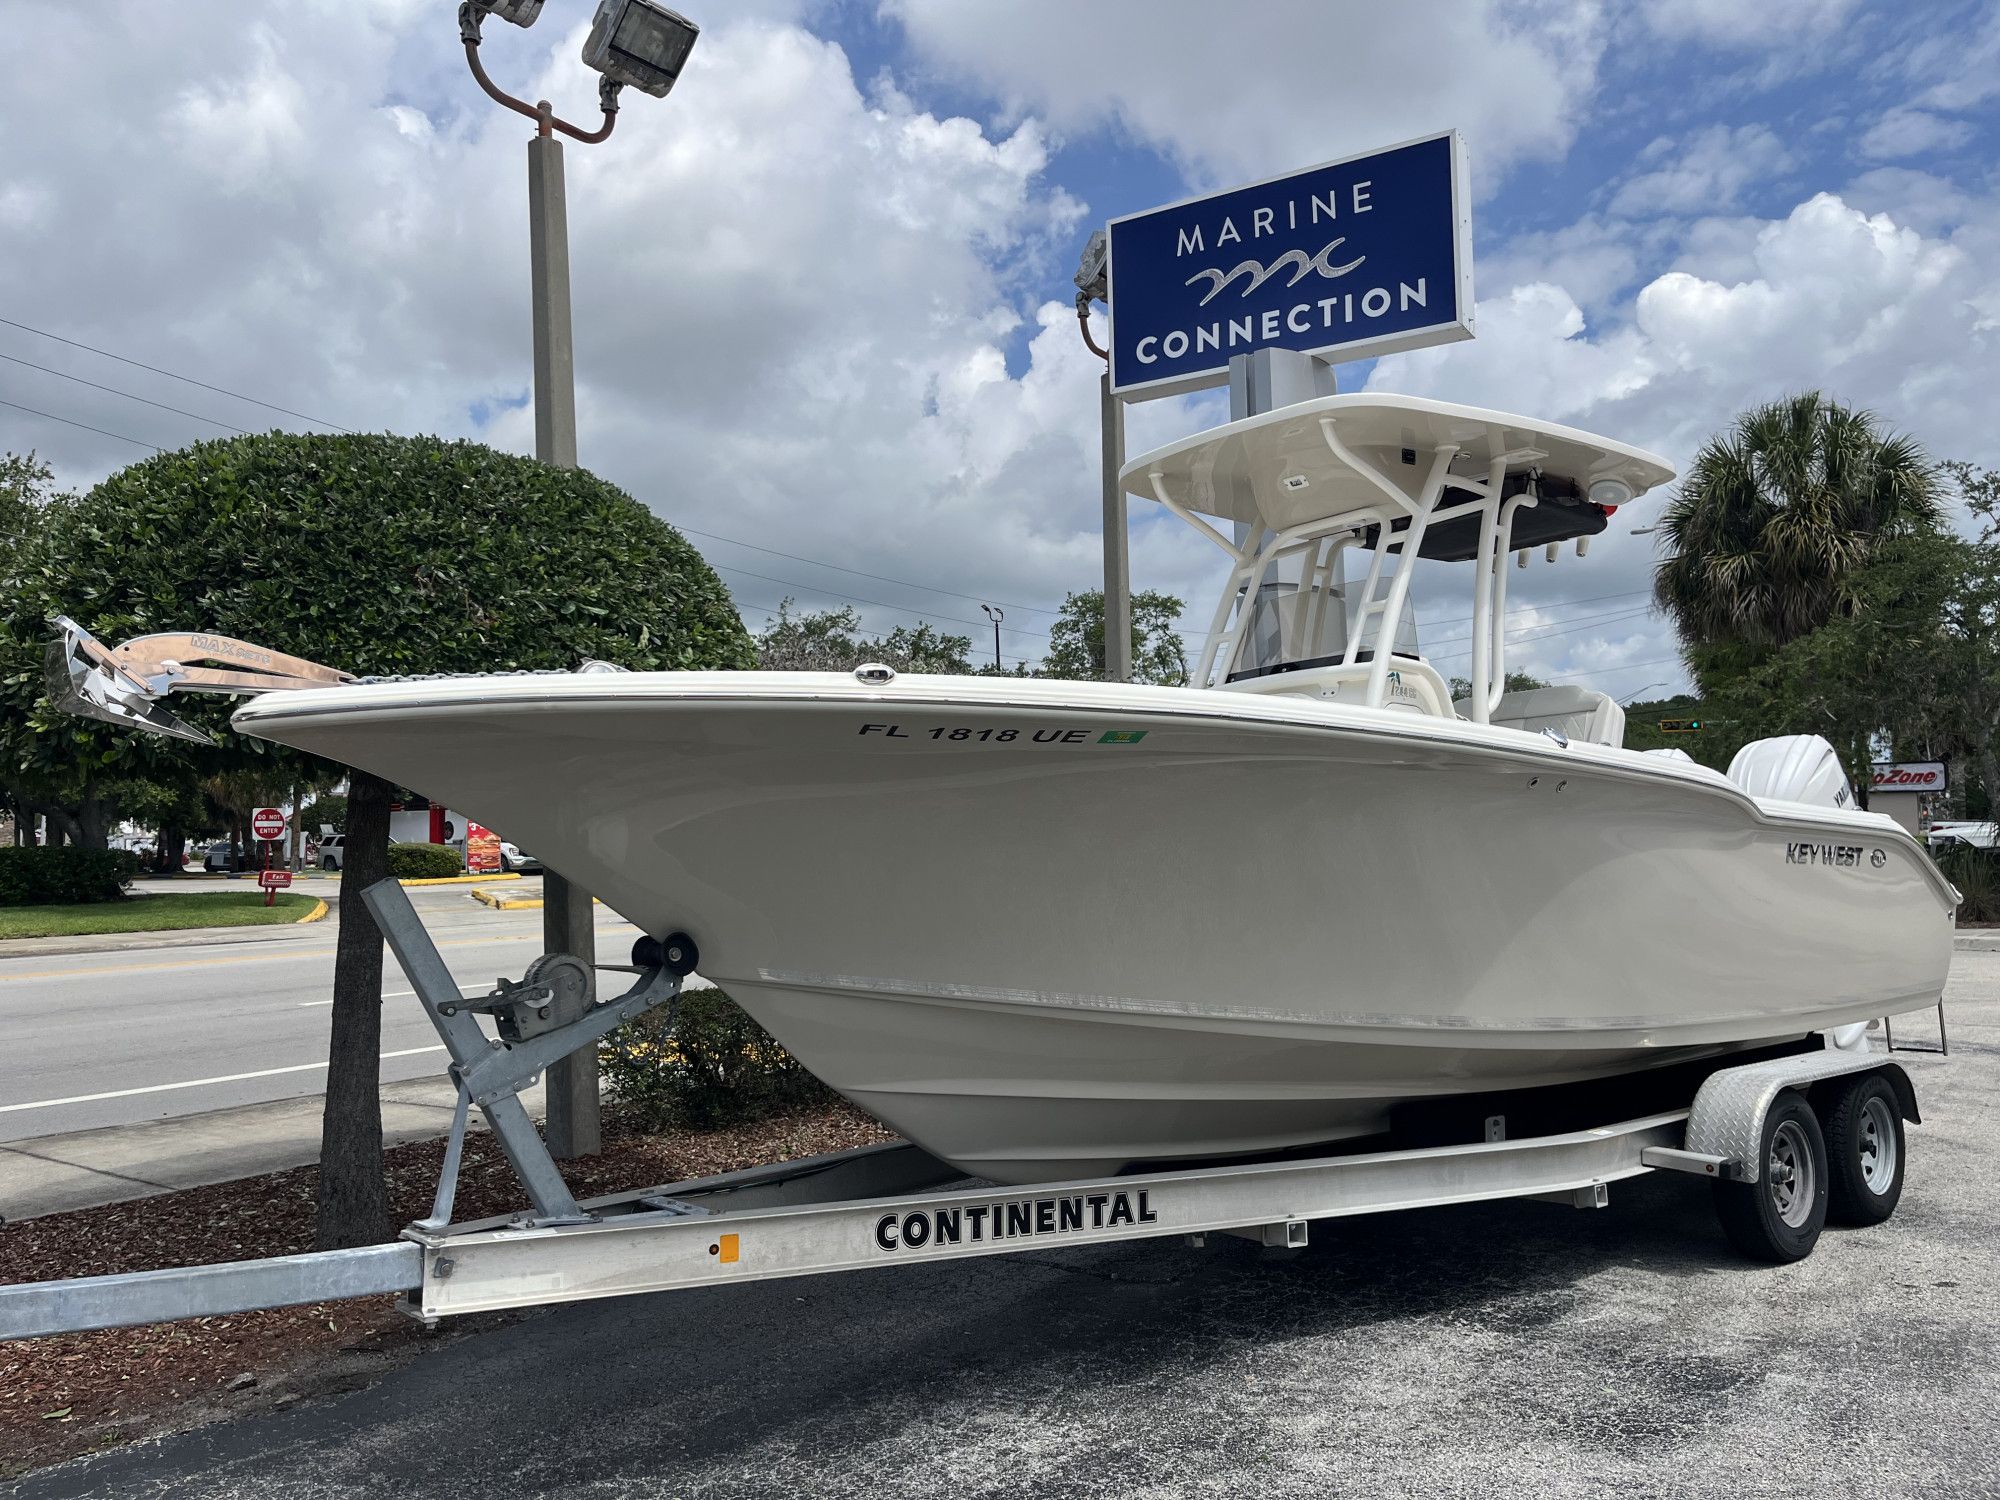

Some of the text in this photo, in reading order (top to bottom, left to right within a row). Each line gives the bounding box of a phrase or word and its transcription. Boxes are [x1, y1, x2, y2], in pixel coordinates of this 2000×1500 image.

[1176, 180, 1373, 257] MARINE
[1136, 277, 1427, 364] CONNECTION
[858, 723, 909, 737] FL
[928, 727, 1020, 742] 1818
[1032, 730, 1092, 743] UE
[1872, 769, 1938, 785] oZone
[874, 1189, 1158, 1252] CONTINENTAL
